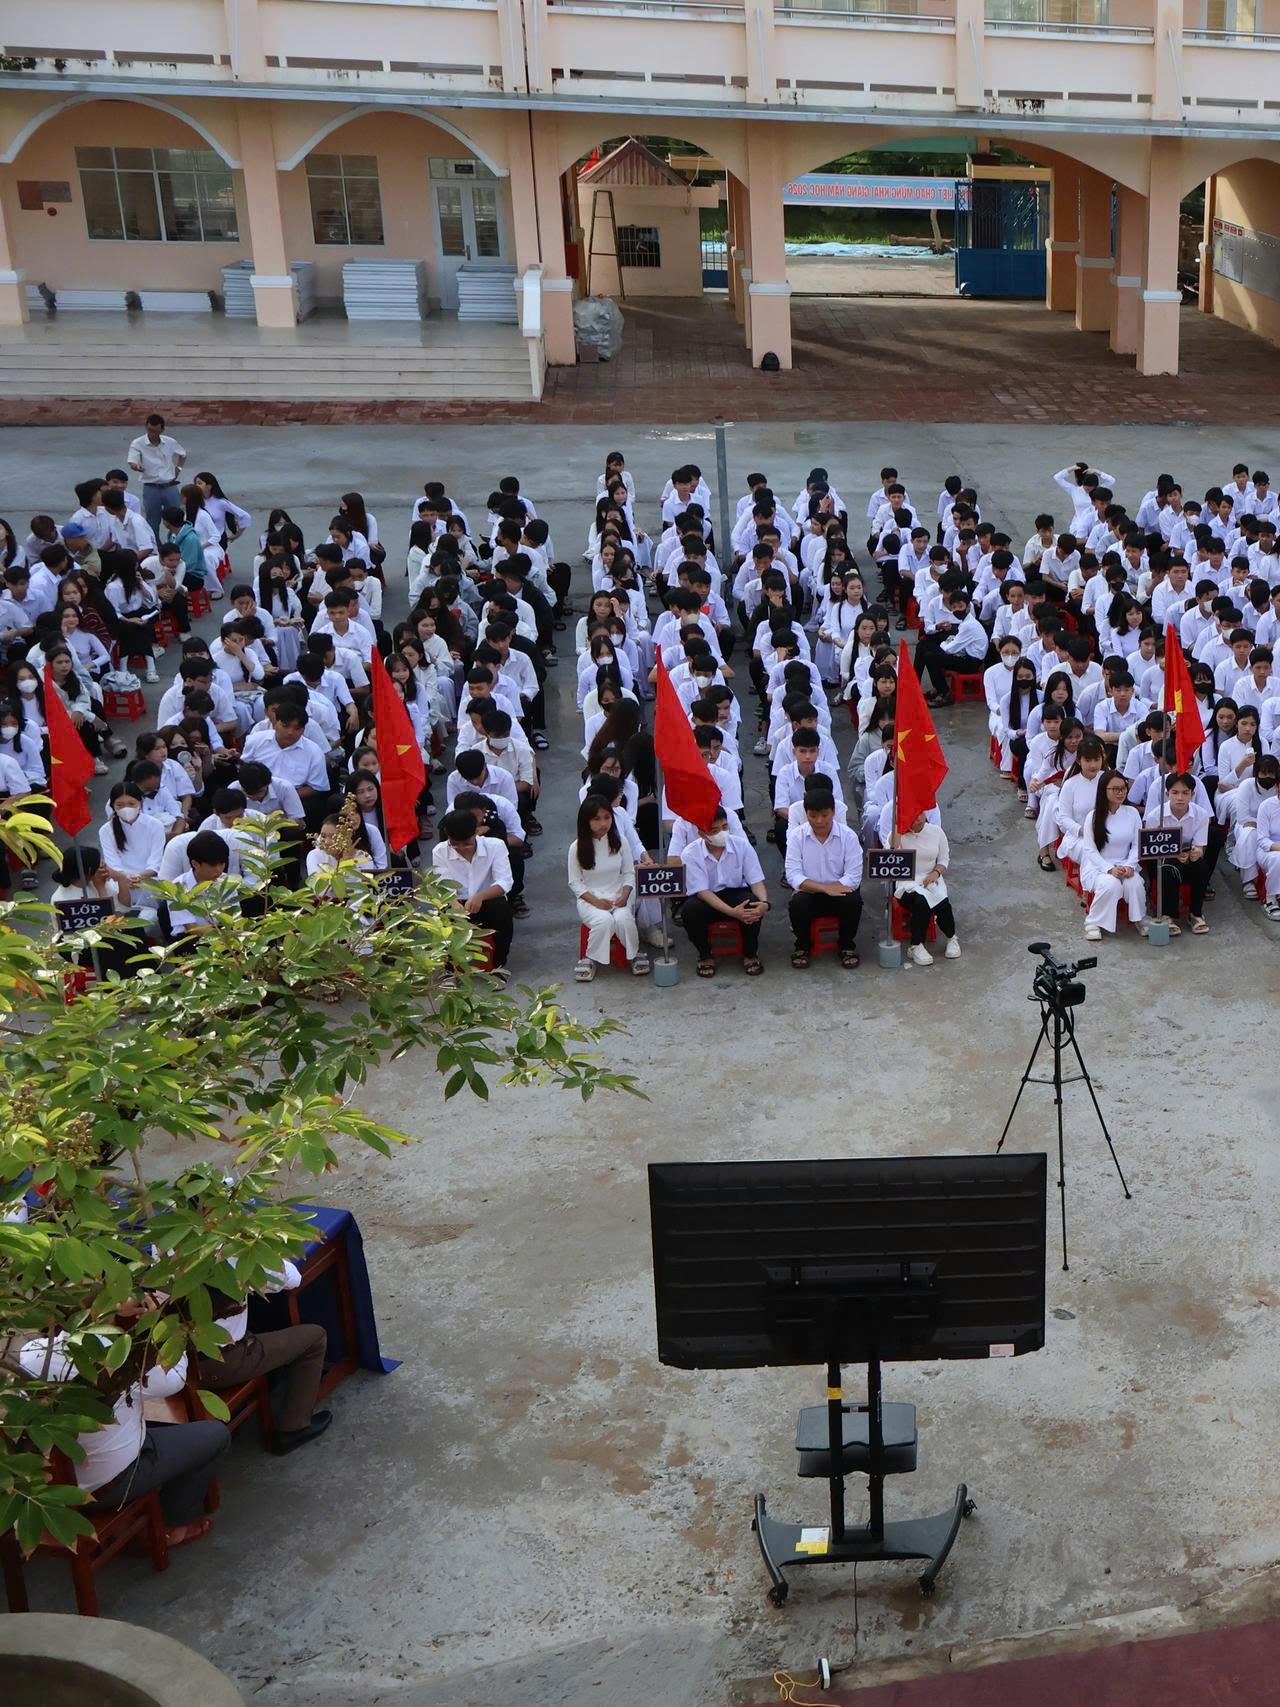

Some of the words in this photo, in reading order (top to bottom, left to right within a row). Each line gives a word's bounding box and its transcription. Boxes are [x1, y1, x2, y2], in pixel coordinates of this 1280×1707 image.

[1149, 831, 1172, 843] LỚP
[1142, 844, 1179, 856] 10C3
[879, 854, 905, 865] LỚP
[647, 870, 674, 881] LỚP
[871, 866, 911, 877] 10C2
[640, 883, 681, 894] 10C1
